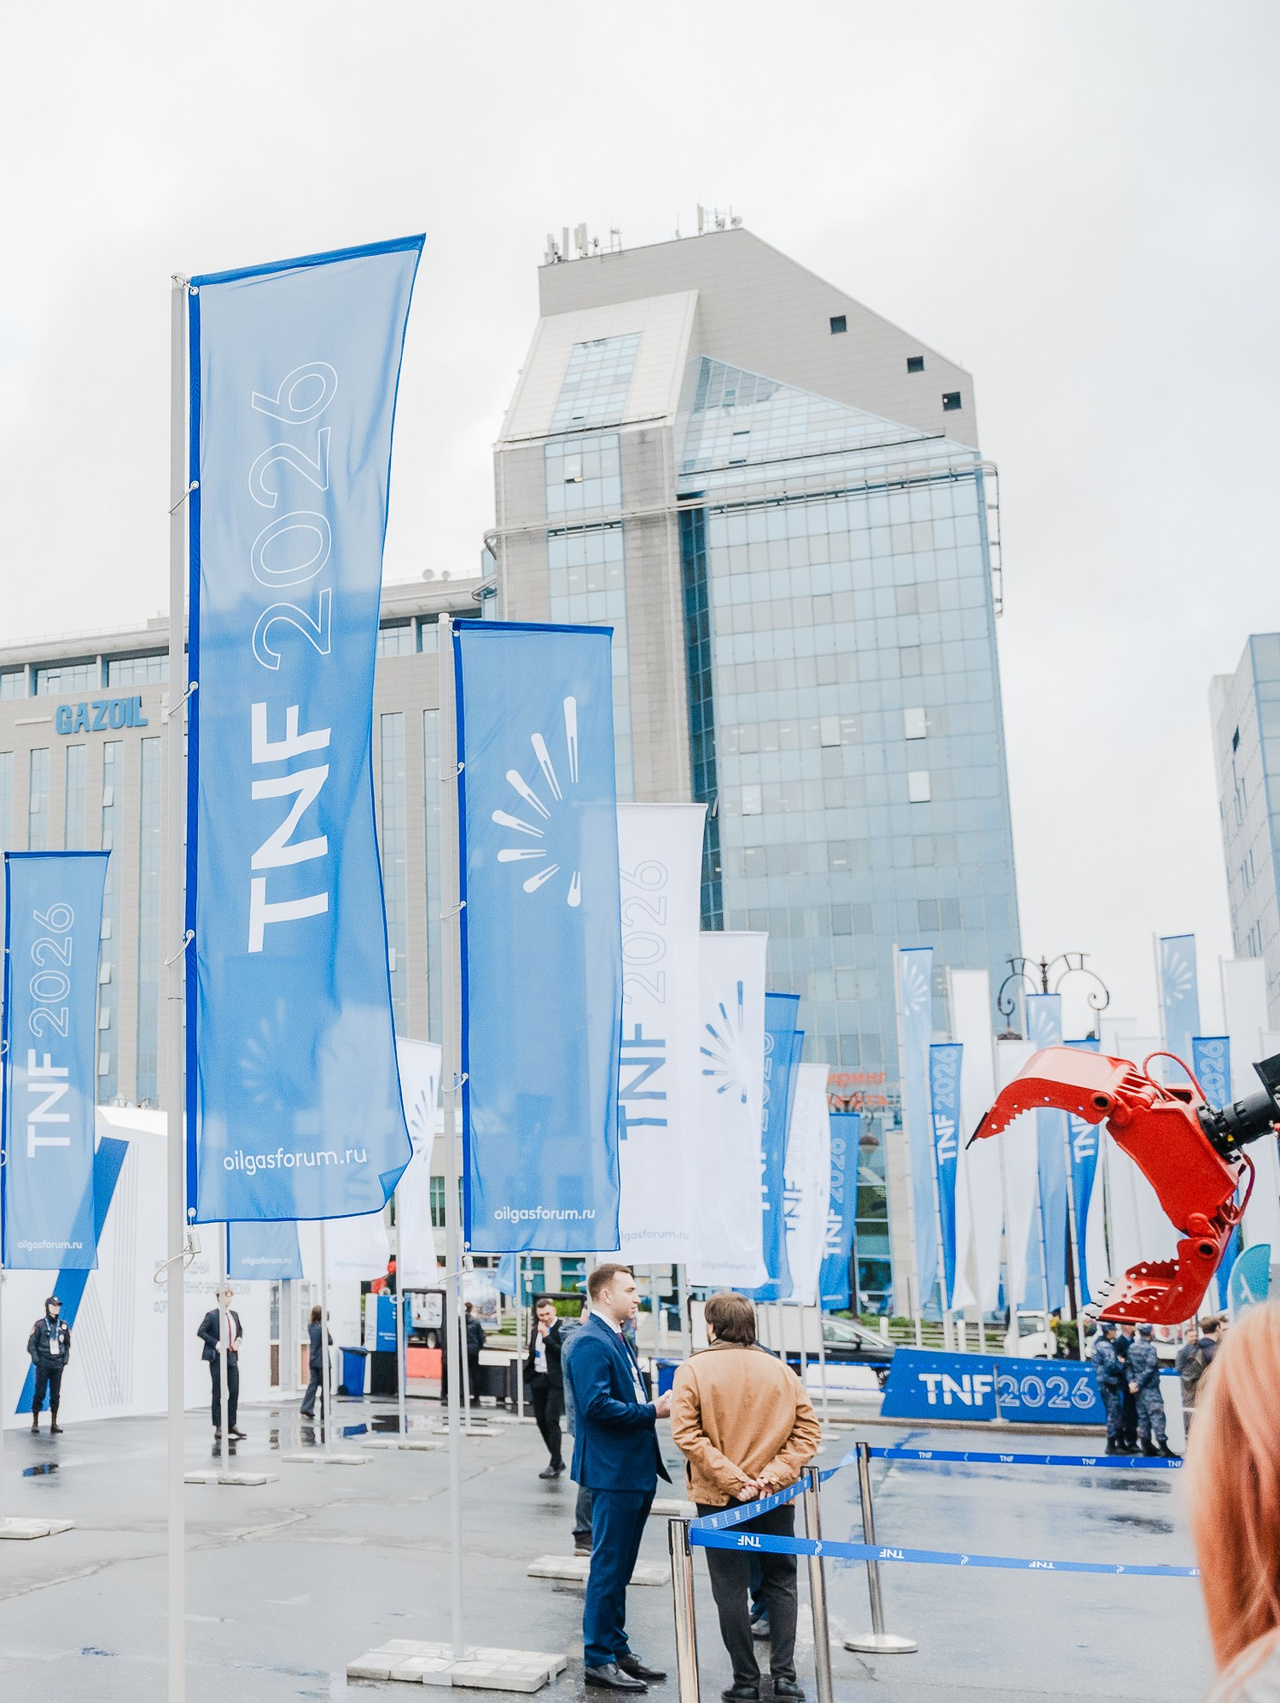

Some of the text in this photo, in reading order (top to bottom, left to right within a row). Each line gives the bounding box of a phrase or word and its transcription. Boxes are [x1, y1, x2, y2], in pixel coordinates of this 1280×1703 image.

[247, 360, 339, 953] TNF 2026
[55, 695, 149, 735] GAZOIL
[618, 859, 669, 1141] TNF 2026
[26, 902, 75, 1159] TNF 2026
[932, 1046, 958, 1167] TNF 2026
[223, 1147, 368, 1176] oilgasforum.ru
[494, 1205, 596, 1224] oilgasforum.ru
[615, 1228, 690, 1242] lgasforum.ru
[823, 1208, 843, 1260] TNF
[17, 1239, 83, 1252] oilgasforum.ru
[918, 1372, 1096, 1410] TNF 2026
[918, 1451, 933, 1460] TNF
[999, 1454, 1014, 1463] TNF
[1081, 1457, 1097, 1466] TNF
[1167, 1459, 1183, 1468] TNF
[737, 1534, 762, 1548] TNF
[878, 1548, 905, 1560] TNF
[1028, 1560, 1056, 1570] TNF
